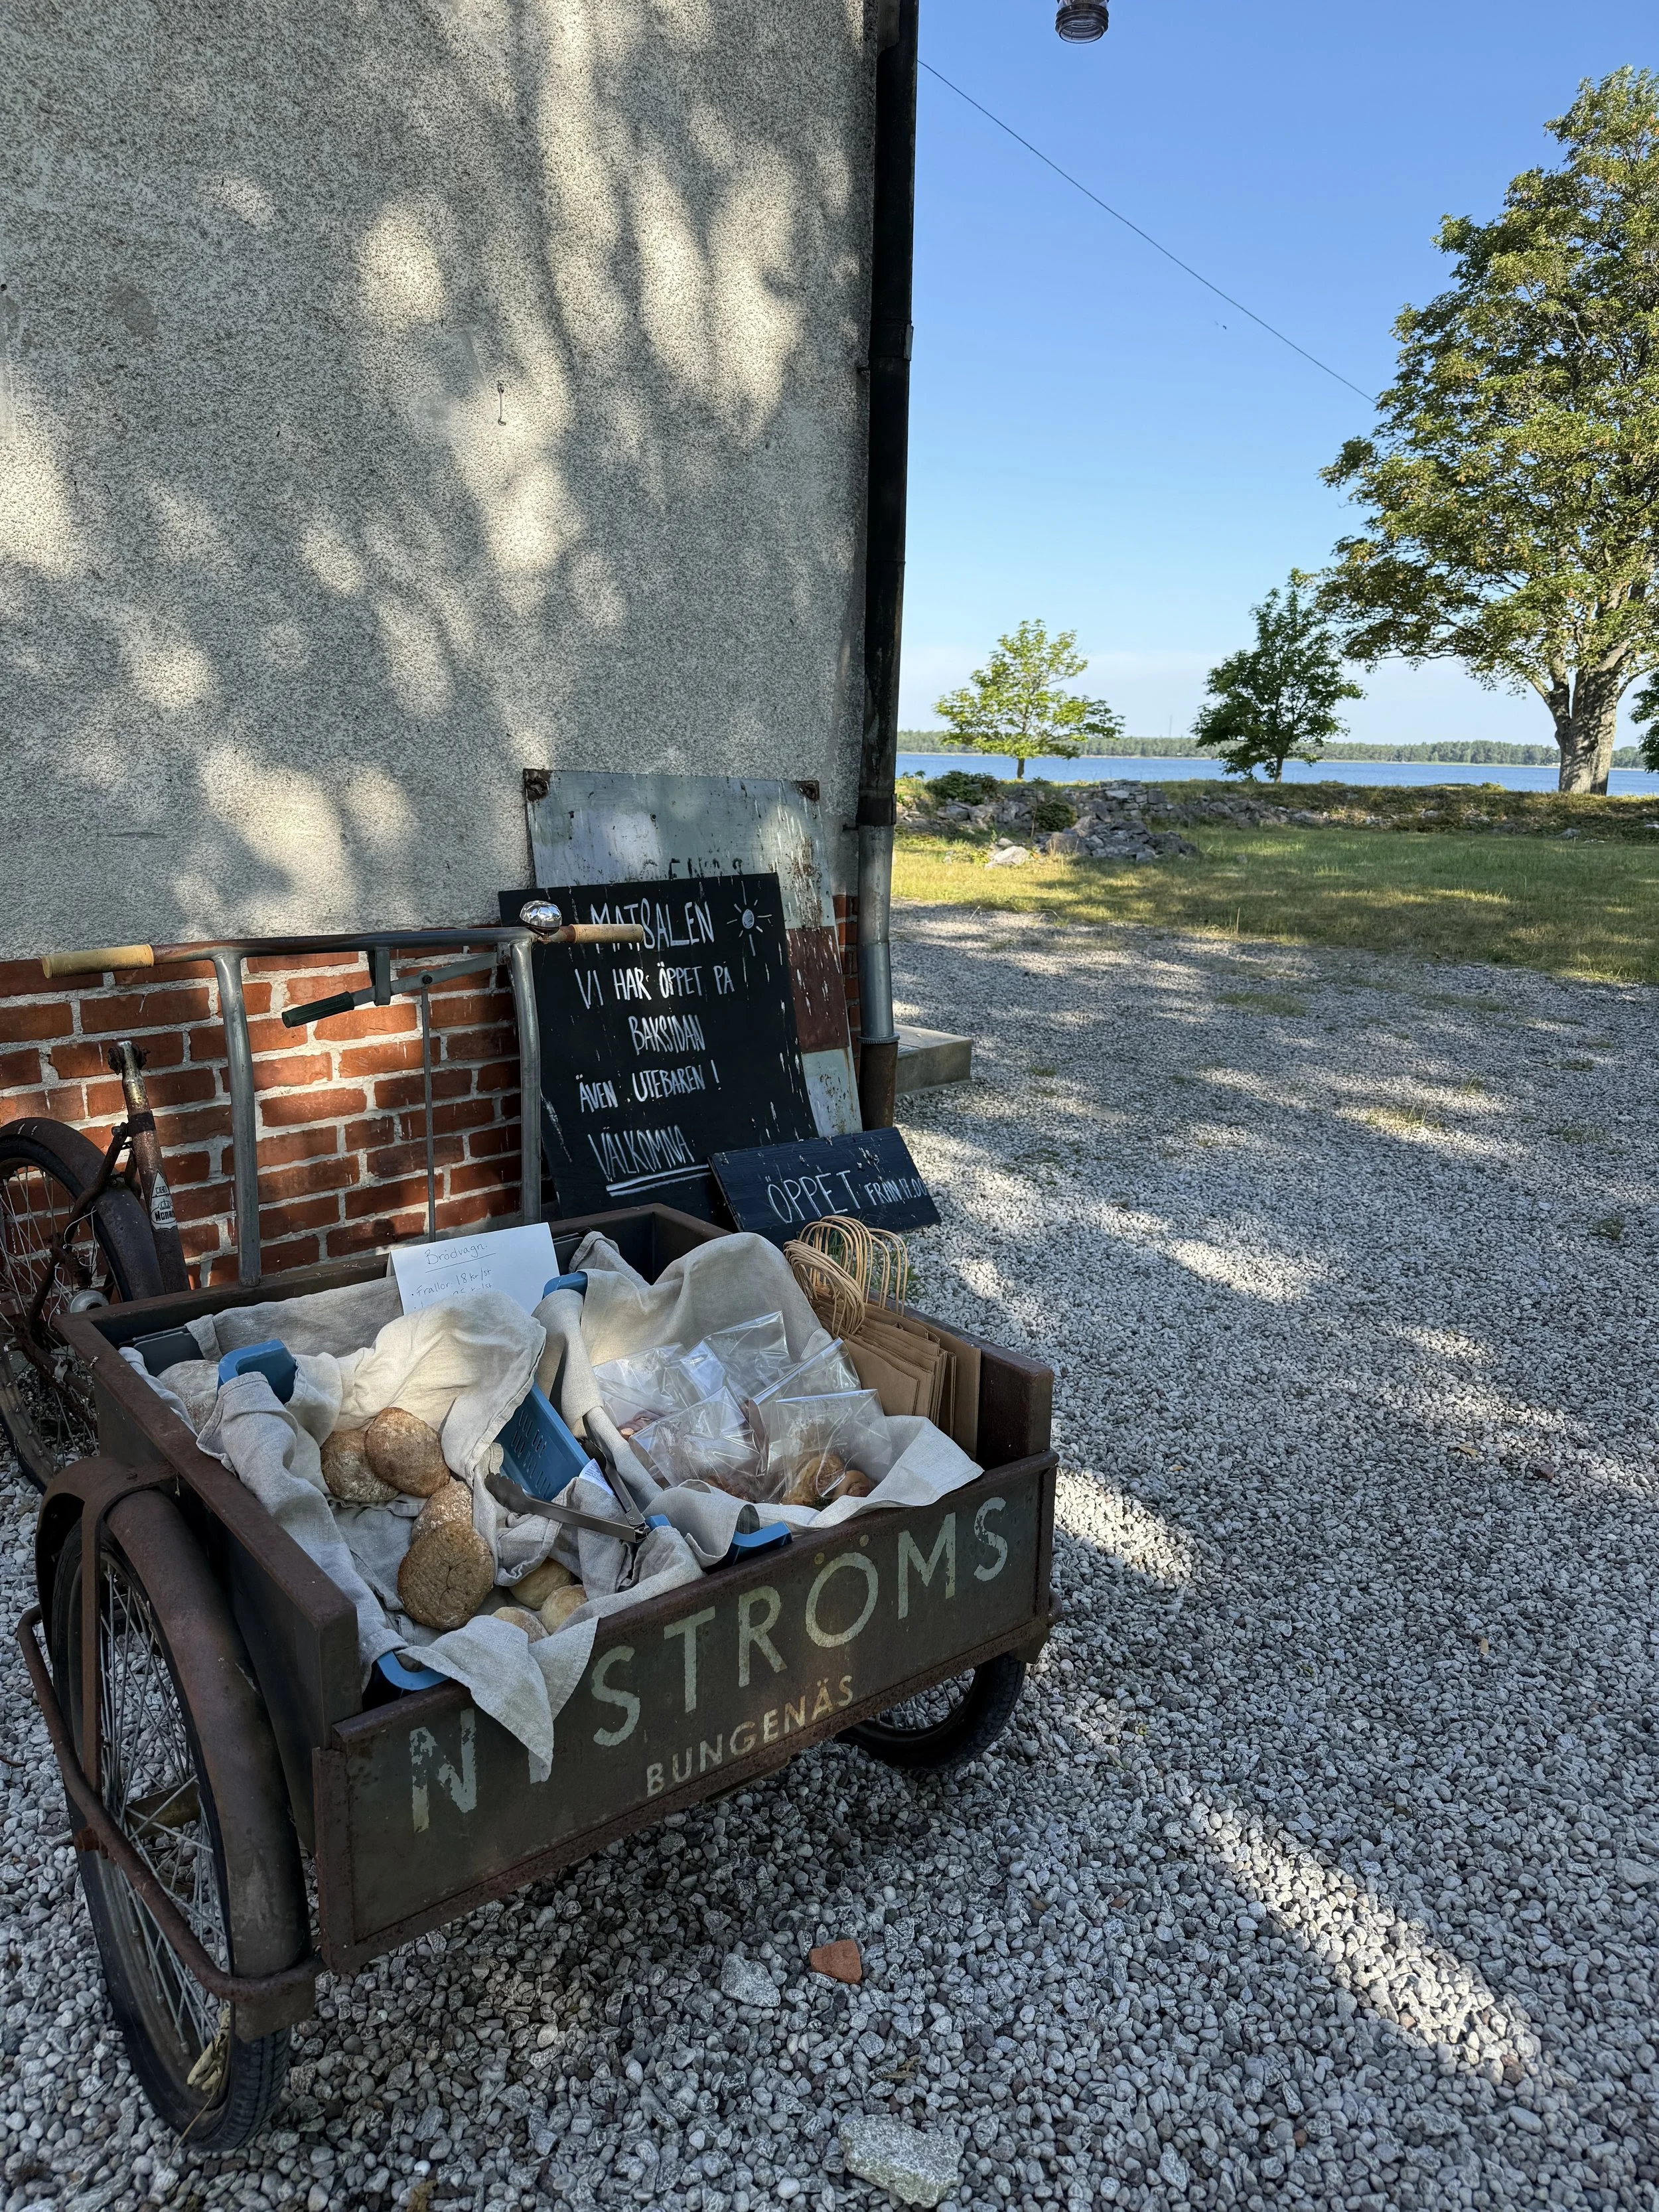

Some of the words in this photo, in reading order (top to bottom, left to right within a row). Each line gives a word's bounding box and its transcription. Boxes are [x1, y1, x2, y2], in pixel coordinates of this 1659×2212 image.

[590, 897, 715, 954] MATSALEN
[575, 968, 604, 1009] VI
[612, 966, 652, 1001] HAR
[657, 961, 703, 999] ÖPPET
[628, 1014, 706, 1056] BAKSIDAN
[575, 1073, 618, 1113] ÄVEN
[632, 1064, 707, 1103] UTEBAREN
[587, 1124, 695, 1183] VÄLKOMNA
[764, 1169, 861, 1224] ÖPPET
[456, 1272, 467, 1286] 18
[409, 1495, 1009, 1834] NSTRÖMS
[645, 1674, 854, 1797] BUNGENÄS
